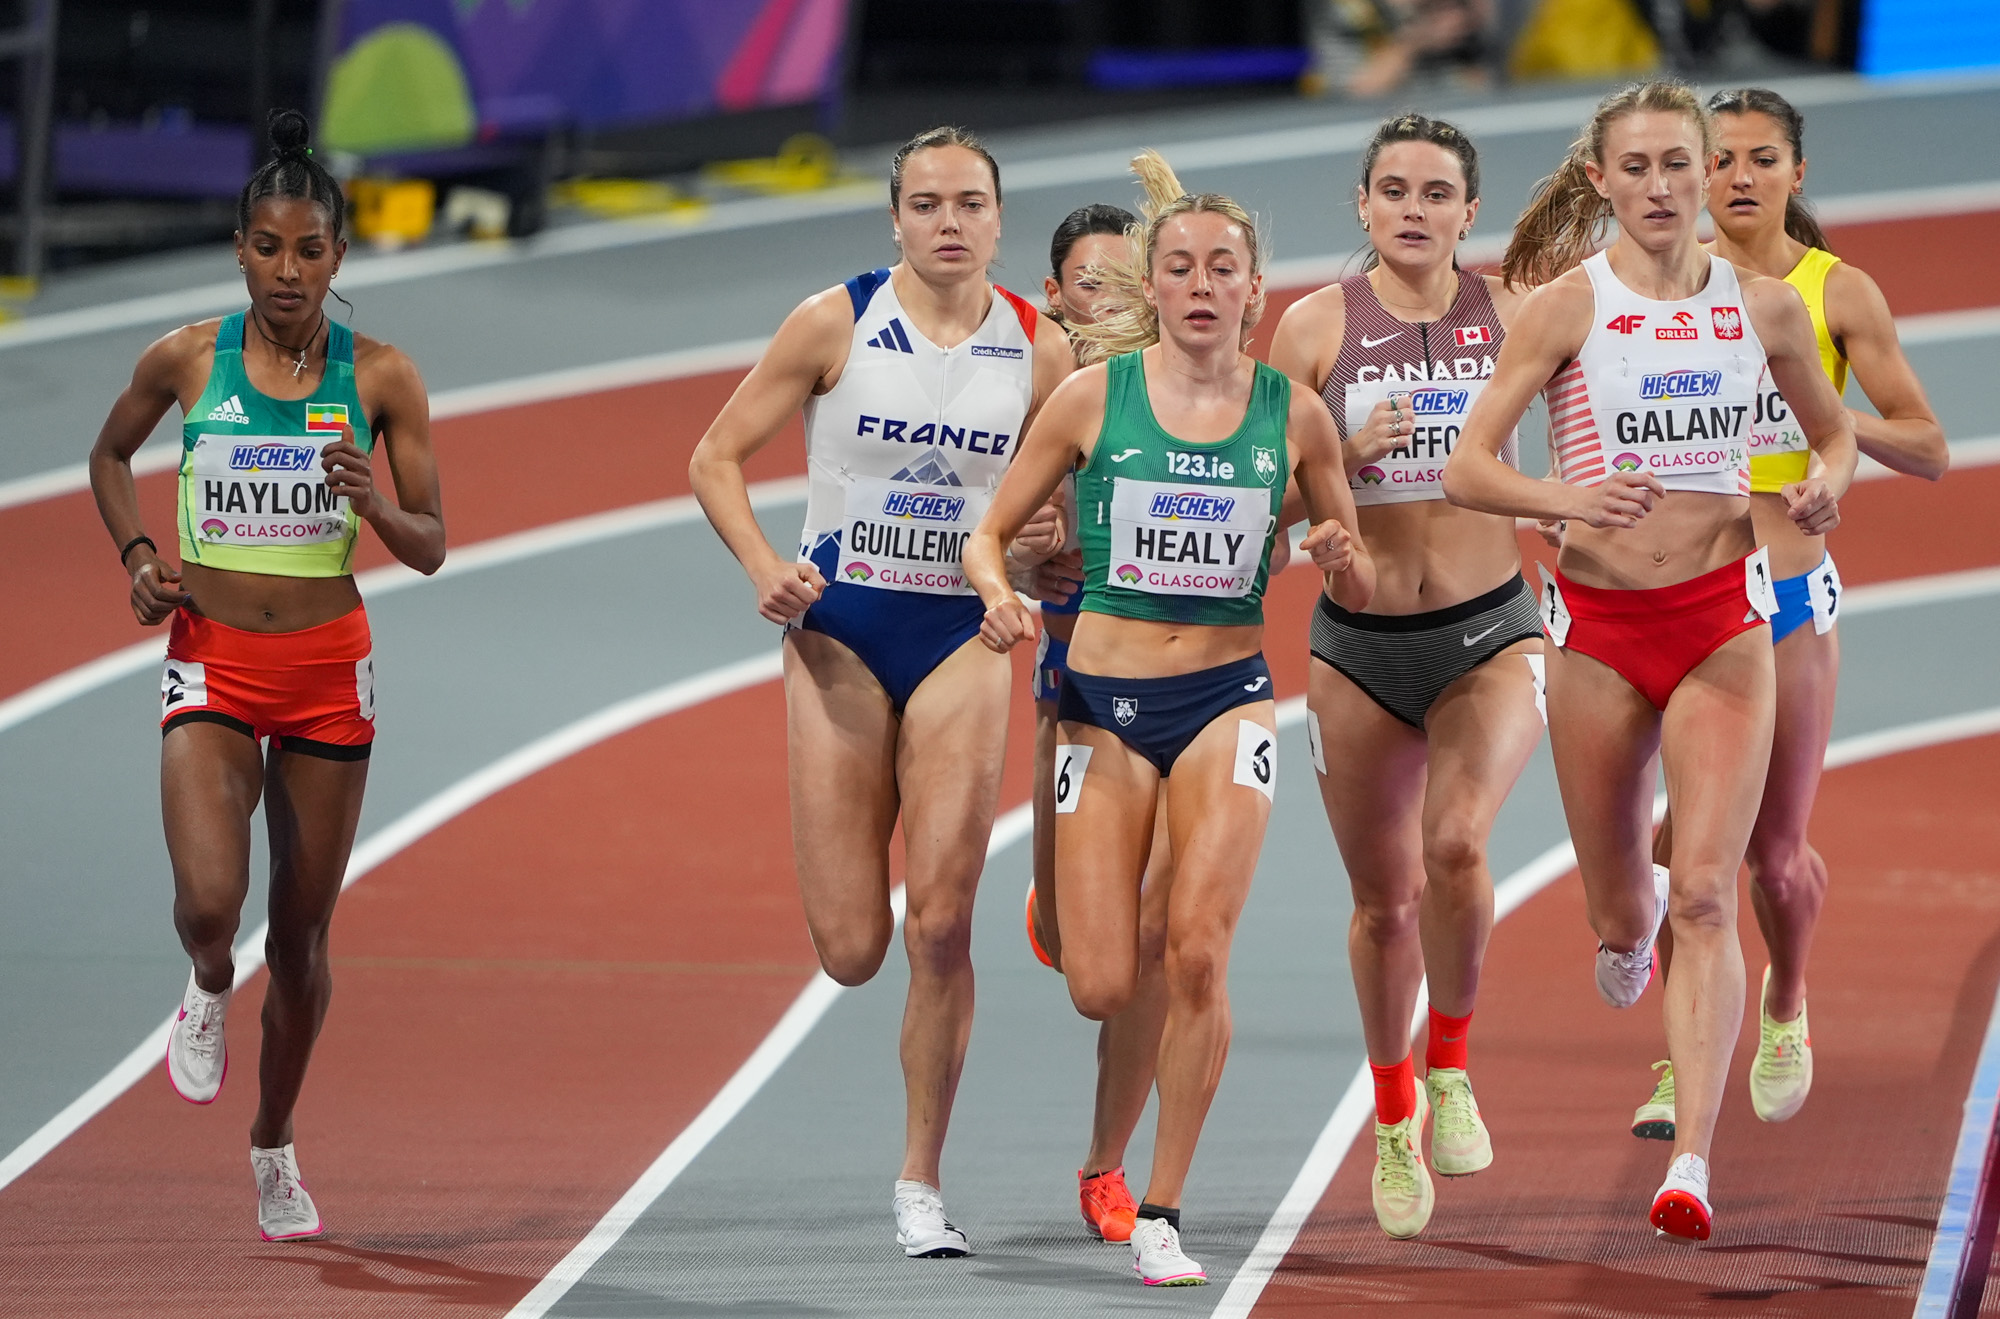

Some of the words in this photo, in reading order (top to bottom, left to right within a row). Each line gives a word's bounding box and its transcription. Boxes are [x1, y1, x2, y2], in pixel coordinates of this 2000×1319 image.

[1606, 314, 1646, 335] 4F
[1656, 329, 1697, 339] ORLEN
[972, 347, 993, 356] Crédit
[1000, 350, 1023, 358] Mutuel
[1357, 355, 1497, 384] CANADA
[1639, 370, 1722, 399] HI-CHEW
[208, 411, 250, 425] adidas
[1616, 406, 1748, 445] GALANT
[857, 414, 1011, 456] FRANCE
[1781, 430, 1801, 445] 24
[229, 444, 316, 472] HI-CHEW
[1165, 451, 1235, 480] 123.ie
[1730, 448, 1742, 462] 24
[204, 479, 338, 515] HAYLOM
[883, 490, 966, 521] HI-CHEW
[1149, 492, 1236, 522] HI-CHEW
[234, 523, 323, 538] GLASGOW
[326, 521, 343, 535] 24
[1135, 526, 1245, 566] HEALY
[880, 569, 963, 588] GLASGOW
[1148, 572, 1235, 590] GLASGOW
[1237, 577, 1251, 591] 24
[1822, 572, 1837, 616] 3
[166, 668, 185, 707] 2
[1253, 739, 1271, 785] 6
[1057, 755, 1073, 804] 6
